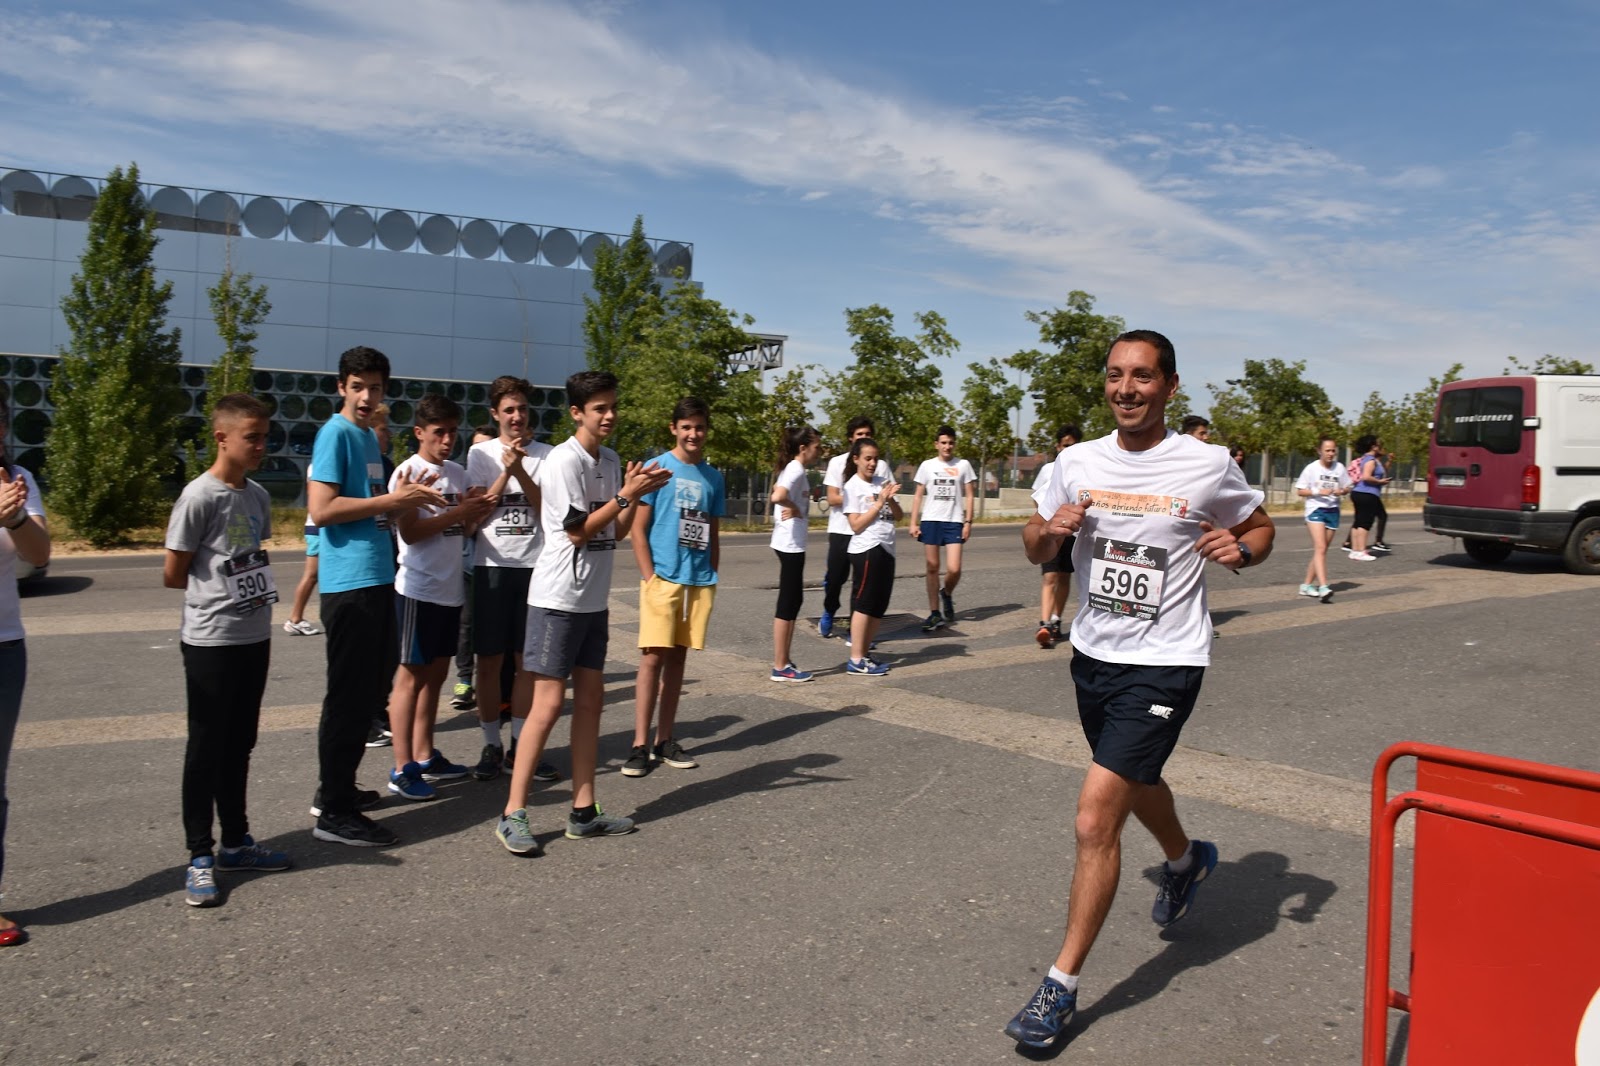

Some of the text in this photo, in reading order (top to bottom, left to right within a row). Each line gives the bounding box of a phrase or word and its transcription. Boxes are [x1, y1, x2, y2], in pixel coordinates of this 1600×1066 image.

[937, 487, 951, 495] 581
[1111, 501, 1142, 512] abriendo
[1144, 502, 1167, 513] futuro
[501, 508, 528, 525] 481
[683, 523, 704, 540] 592
[237, 572, 267, 599] 590
[1101, 567, 1149, 601] 596
